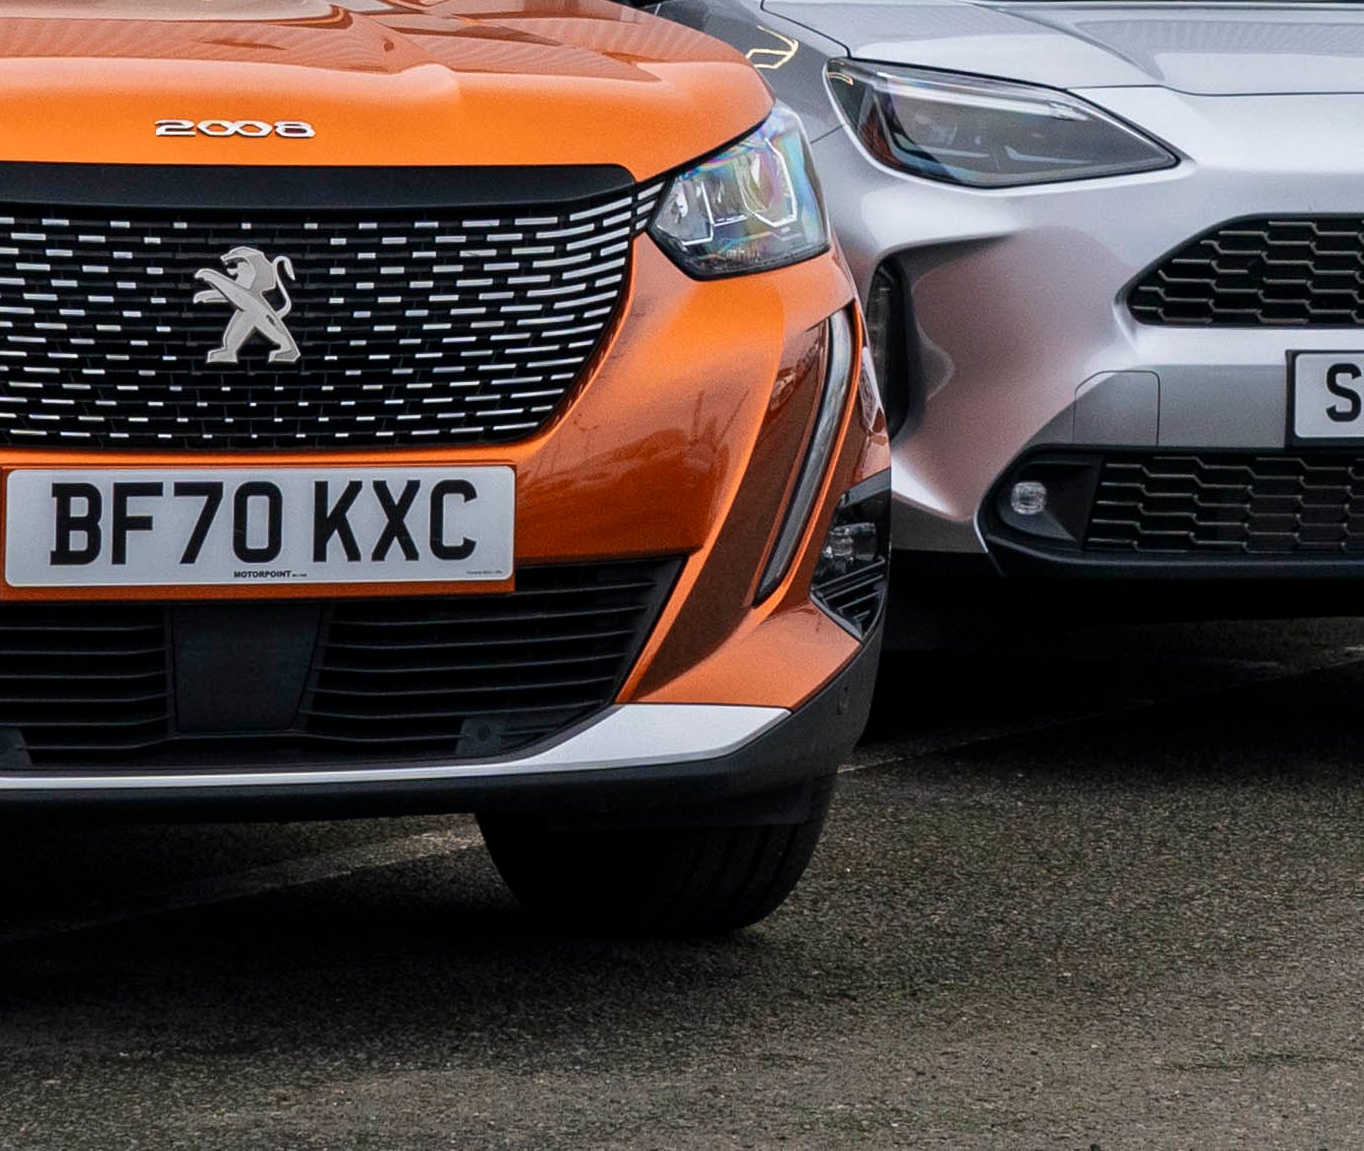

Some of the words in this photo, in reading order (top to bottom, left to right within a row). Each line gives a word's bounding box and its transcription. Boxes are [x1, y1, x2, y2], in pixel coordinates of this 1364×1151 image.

[154, 118, 317, 139] 2008
[49, 480, 283, 566] BF70
[312, 479, 479, 563] KXC
[234, 570, 291, 579] MOTORPOINT
